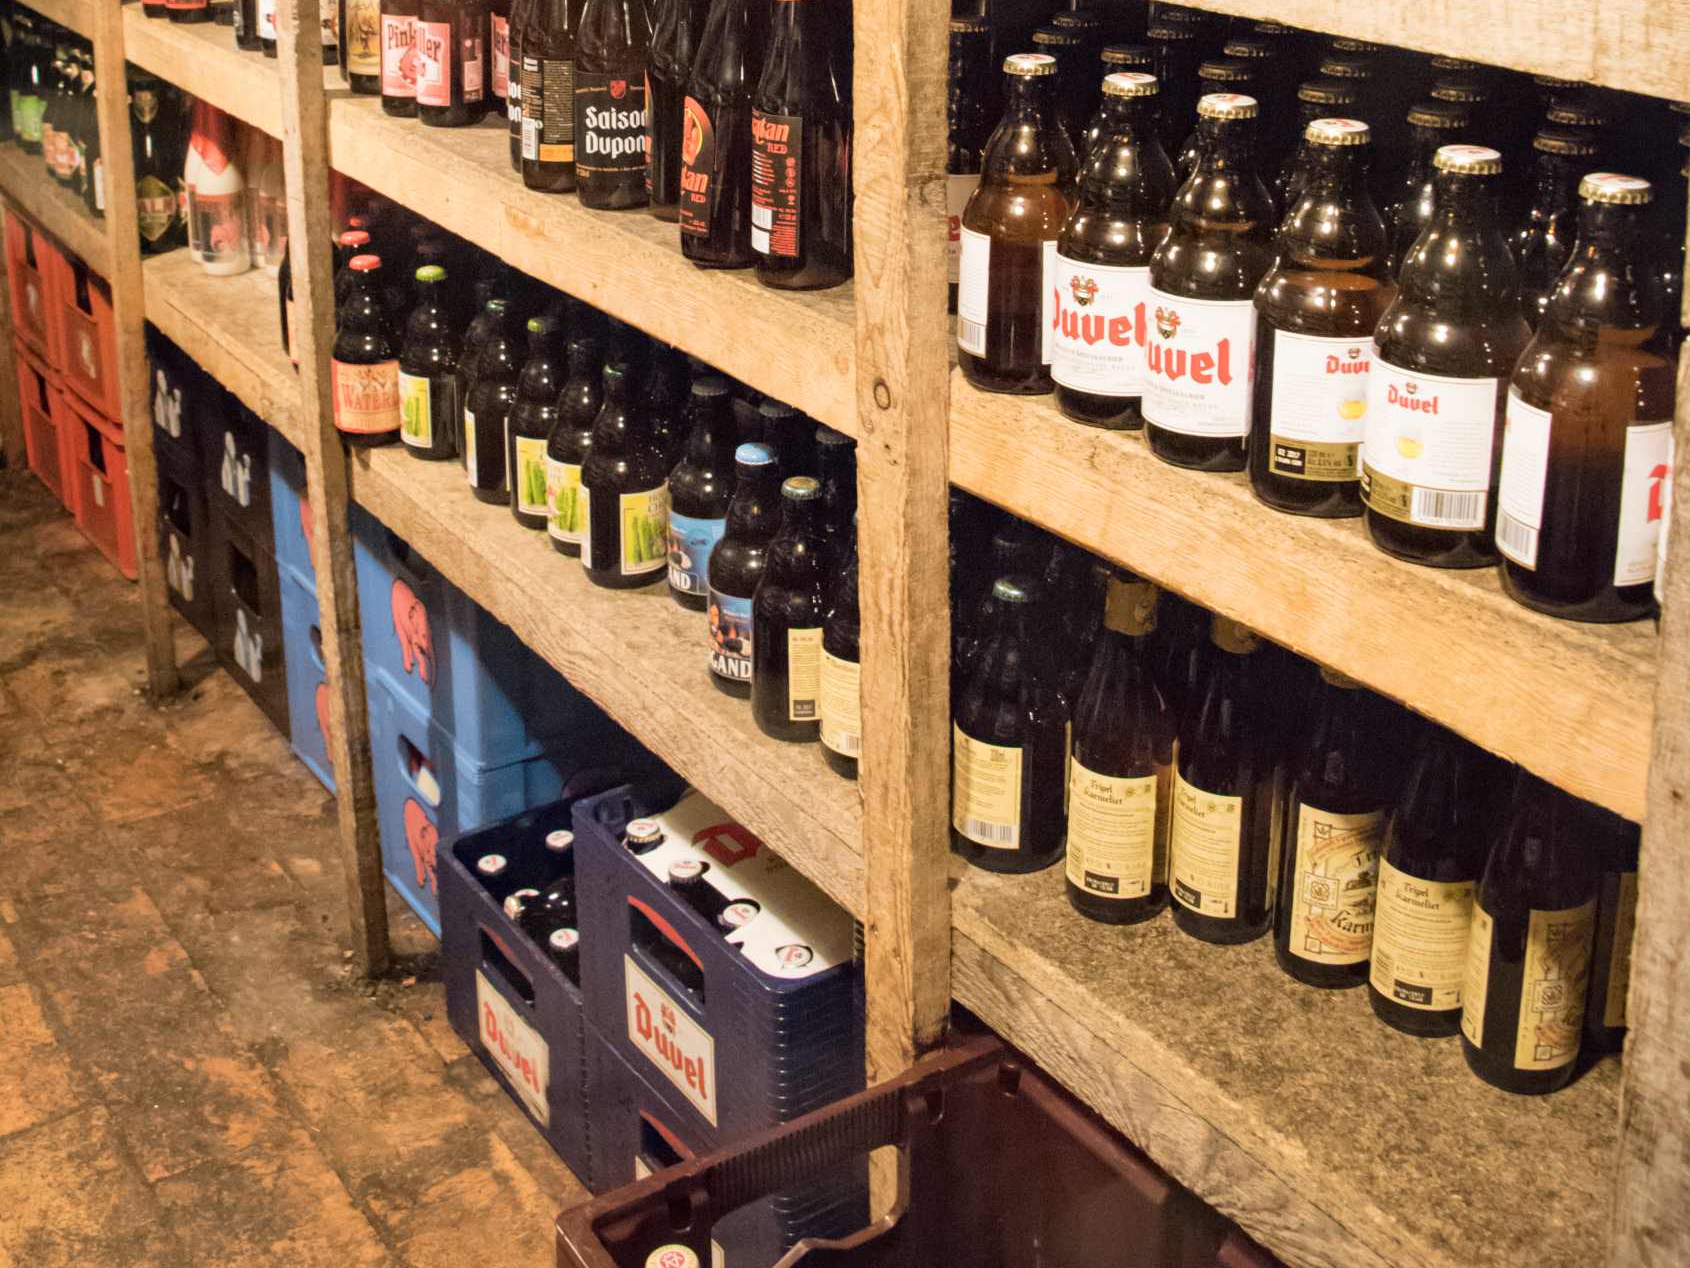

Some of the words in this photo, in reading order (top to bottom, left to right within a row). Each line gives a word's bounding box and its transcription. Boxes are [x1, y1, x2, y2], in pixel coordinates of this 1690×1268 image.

[1387, 383, 1439, 415] Duvel
[1403, 882, 1430, 900] Tripel
[633, 991, 708, 1101] Duvel
